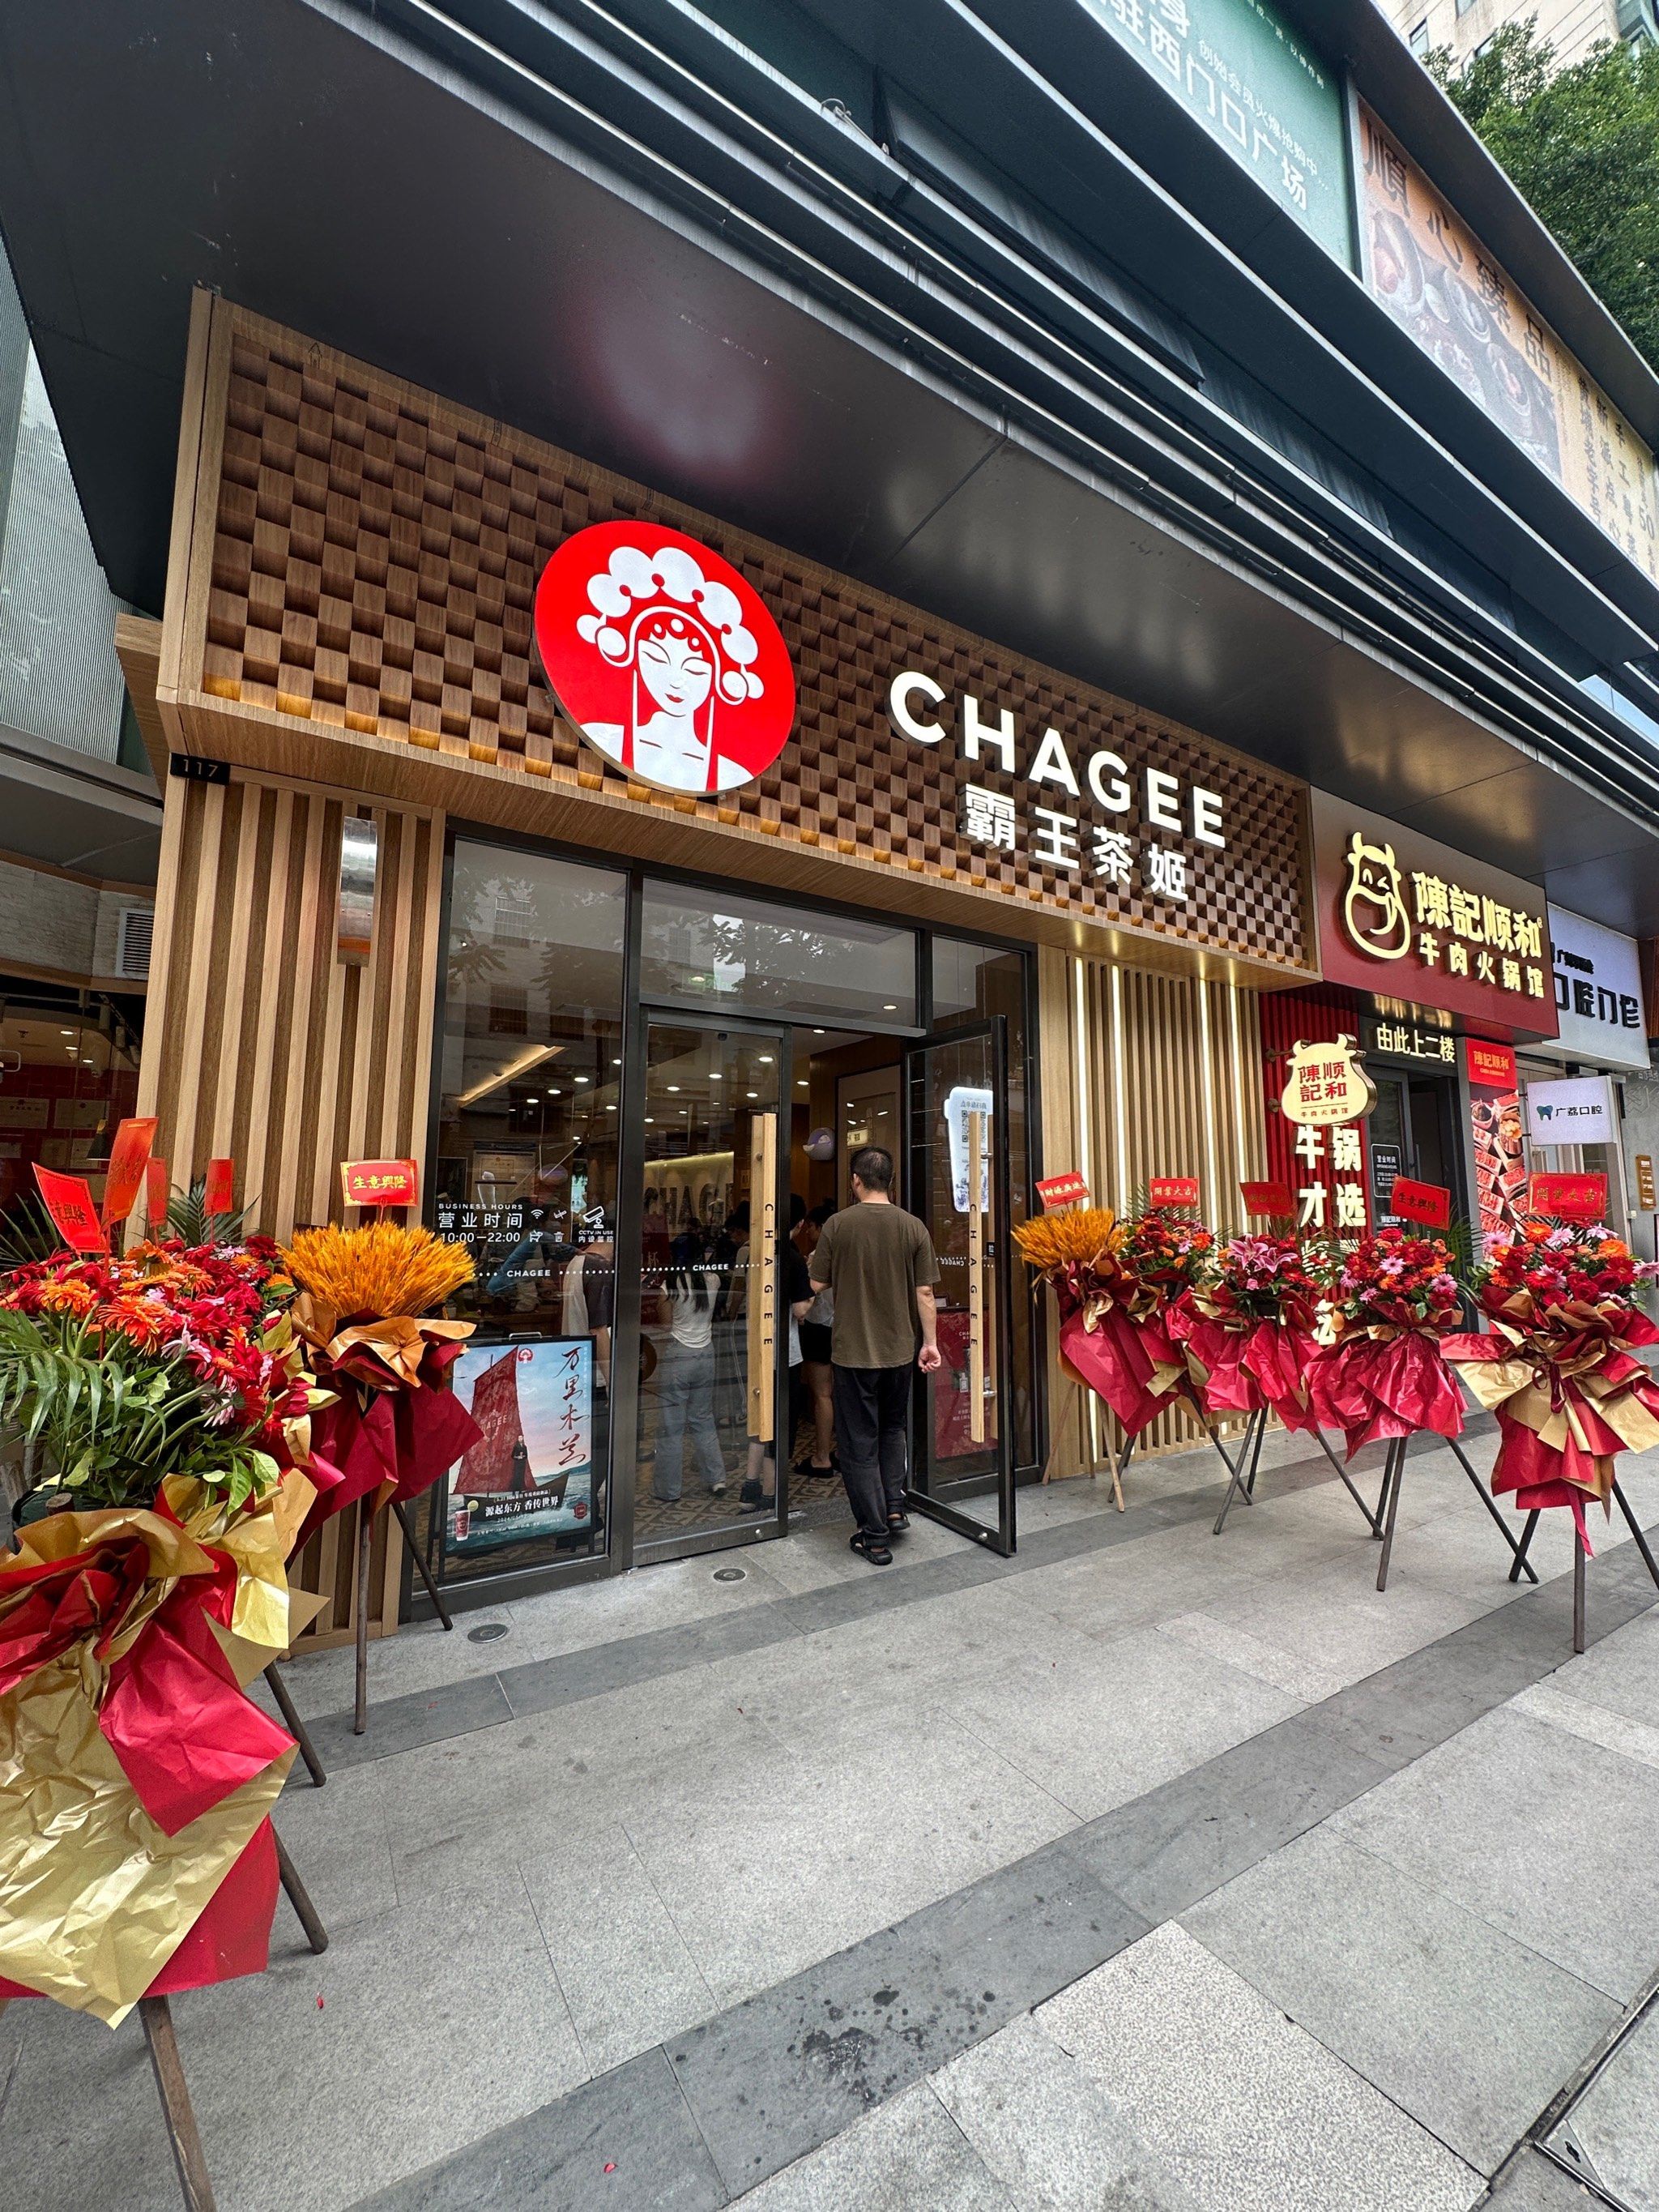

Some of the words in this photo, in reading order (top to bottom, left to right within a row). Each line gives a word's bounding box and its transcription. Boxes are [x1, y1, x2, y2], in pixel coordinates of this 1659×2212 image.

[183, 758, 218, 777] 117
[889, 670, 1226, 848] CHAGEE
[963, 783, 1188, 903] 霸王茶姬
[1419, 932, 1545, 999] 牛肉火锅馆
[1376, 1023, 1456, 1064] 由此上二楼
[1555, 1104, 1603, 1117] 广荔口腔
[352, 1174, 407, 1190] 生意興隆
[438, 1212, 522, 1228] 营业时间
[693, 1263, 729, 1271] CHAGEE
[763, 1203, 774, 1345] CHAGEE
[970, 1203, 978, 1345] CHAGEE
[485, 1501, 522, 1517] 源起东方
[524, 1496, 559, 1510] 香传世界
